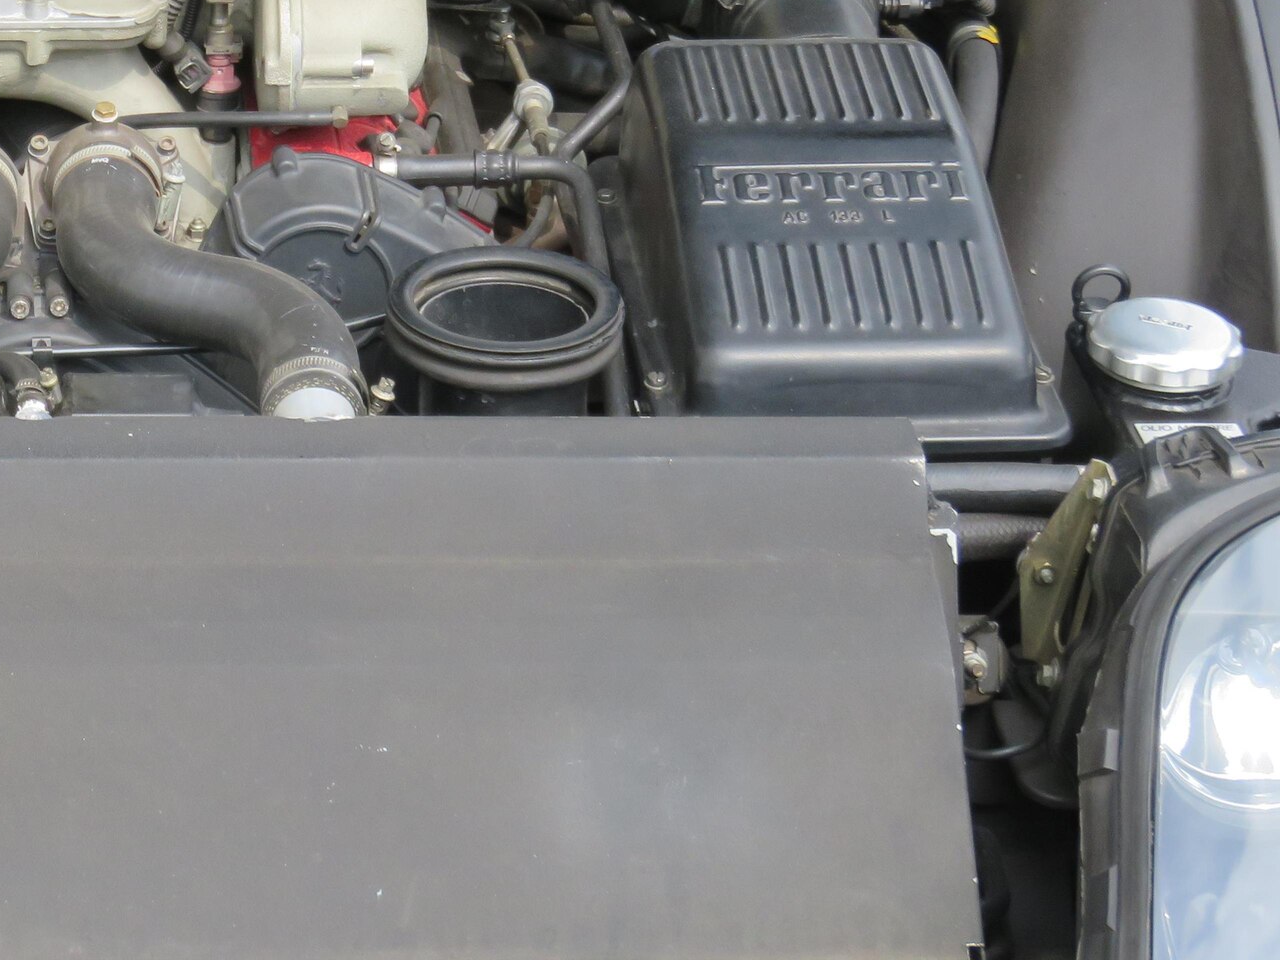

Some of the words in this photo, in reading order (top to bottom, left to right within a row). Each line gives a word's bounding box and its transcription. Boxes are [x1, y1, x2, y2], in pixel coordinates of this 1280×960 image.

[694, 160, 969, 204] Ferrari
[782, 209, 810, 224] AC
[828, 209, 863, 224] 133
[880, 208, 896, 223] L
[1141, 424, 1172, 432] OLIO
[1177, 424, 1233, 432] MRE
